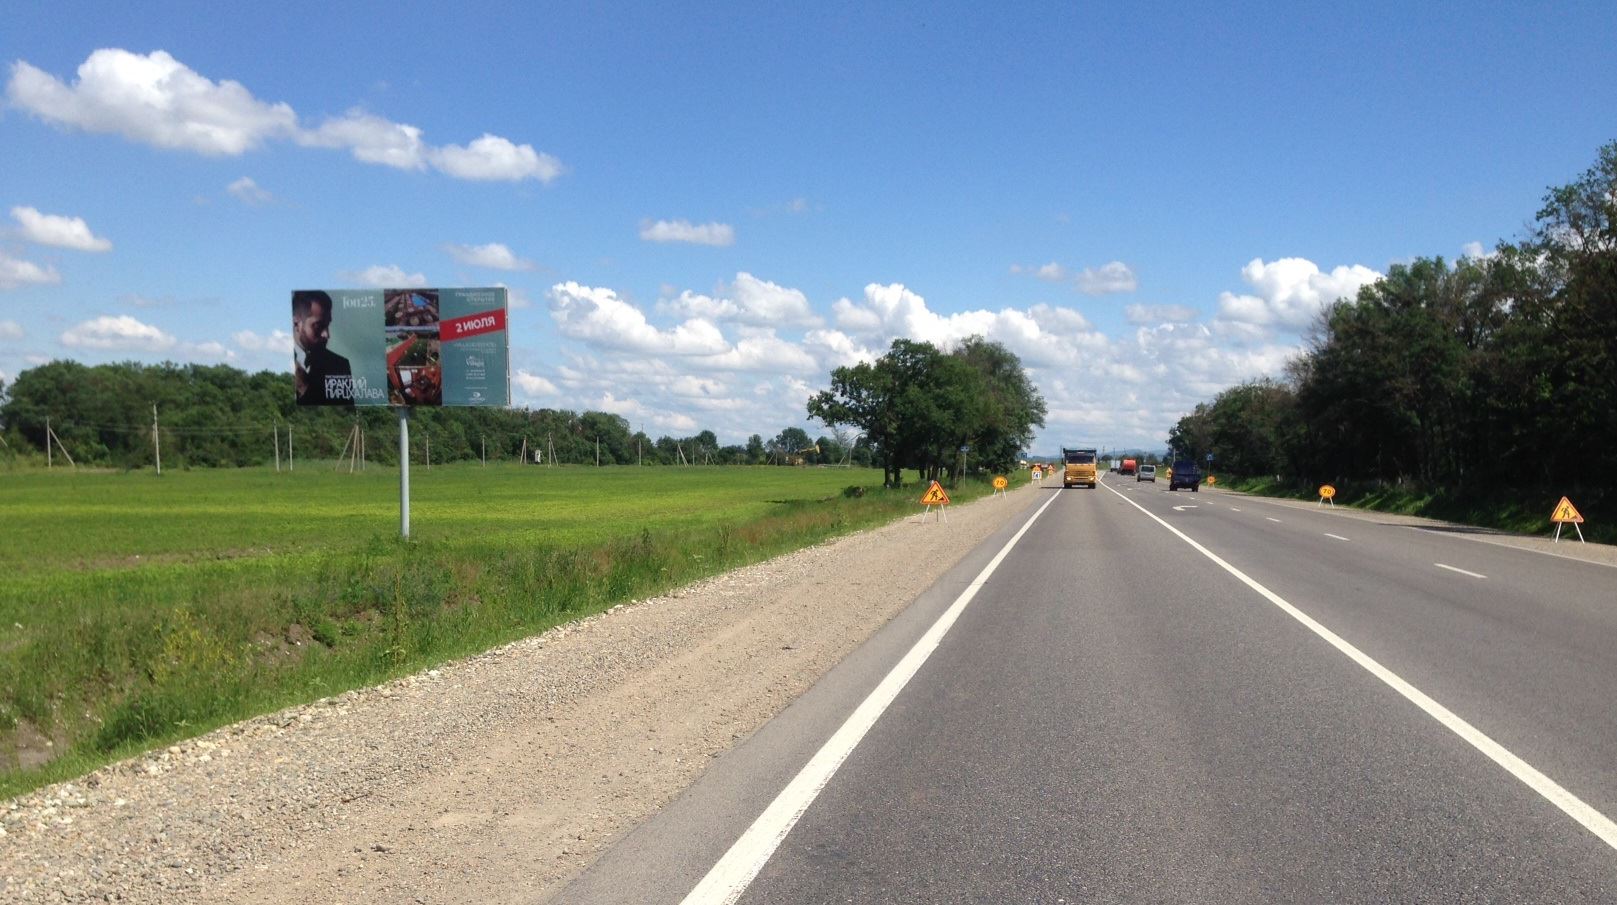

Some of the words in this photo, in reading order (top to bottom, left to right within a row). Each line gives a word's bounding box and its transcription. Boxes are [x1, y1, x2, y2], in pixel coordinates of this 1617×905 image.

[455, 323, 463, 333] 2
[463, 316, 496, 331] ИЮЛЯ
[325, 376, 367, 389] ИРАКЛИЙ
